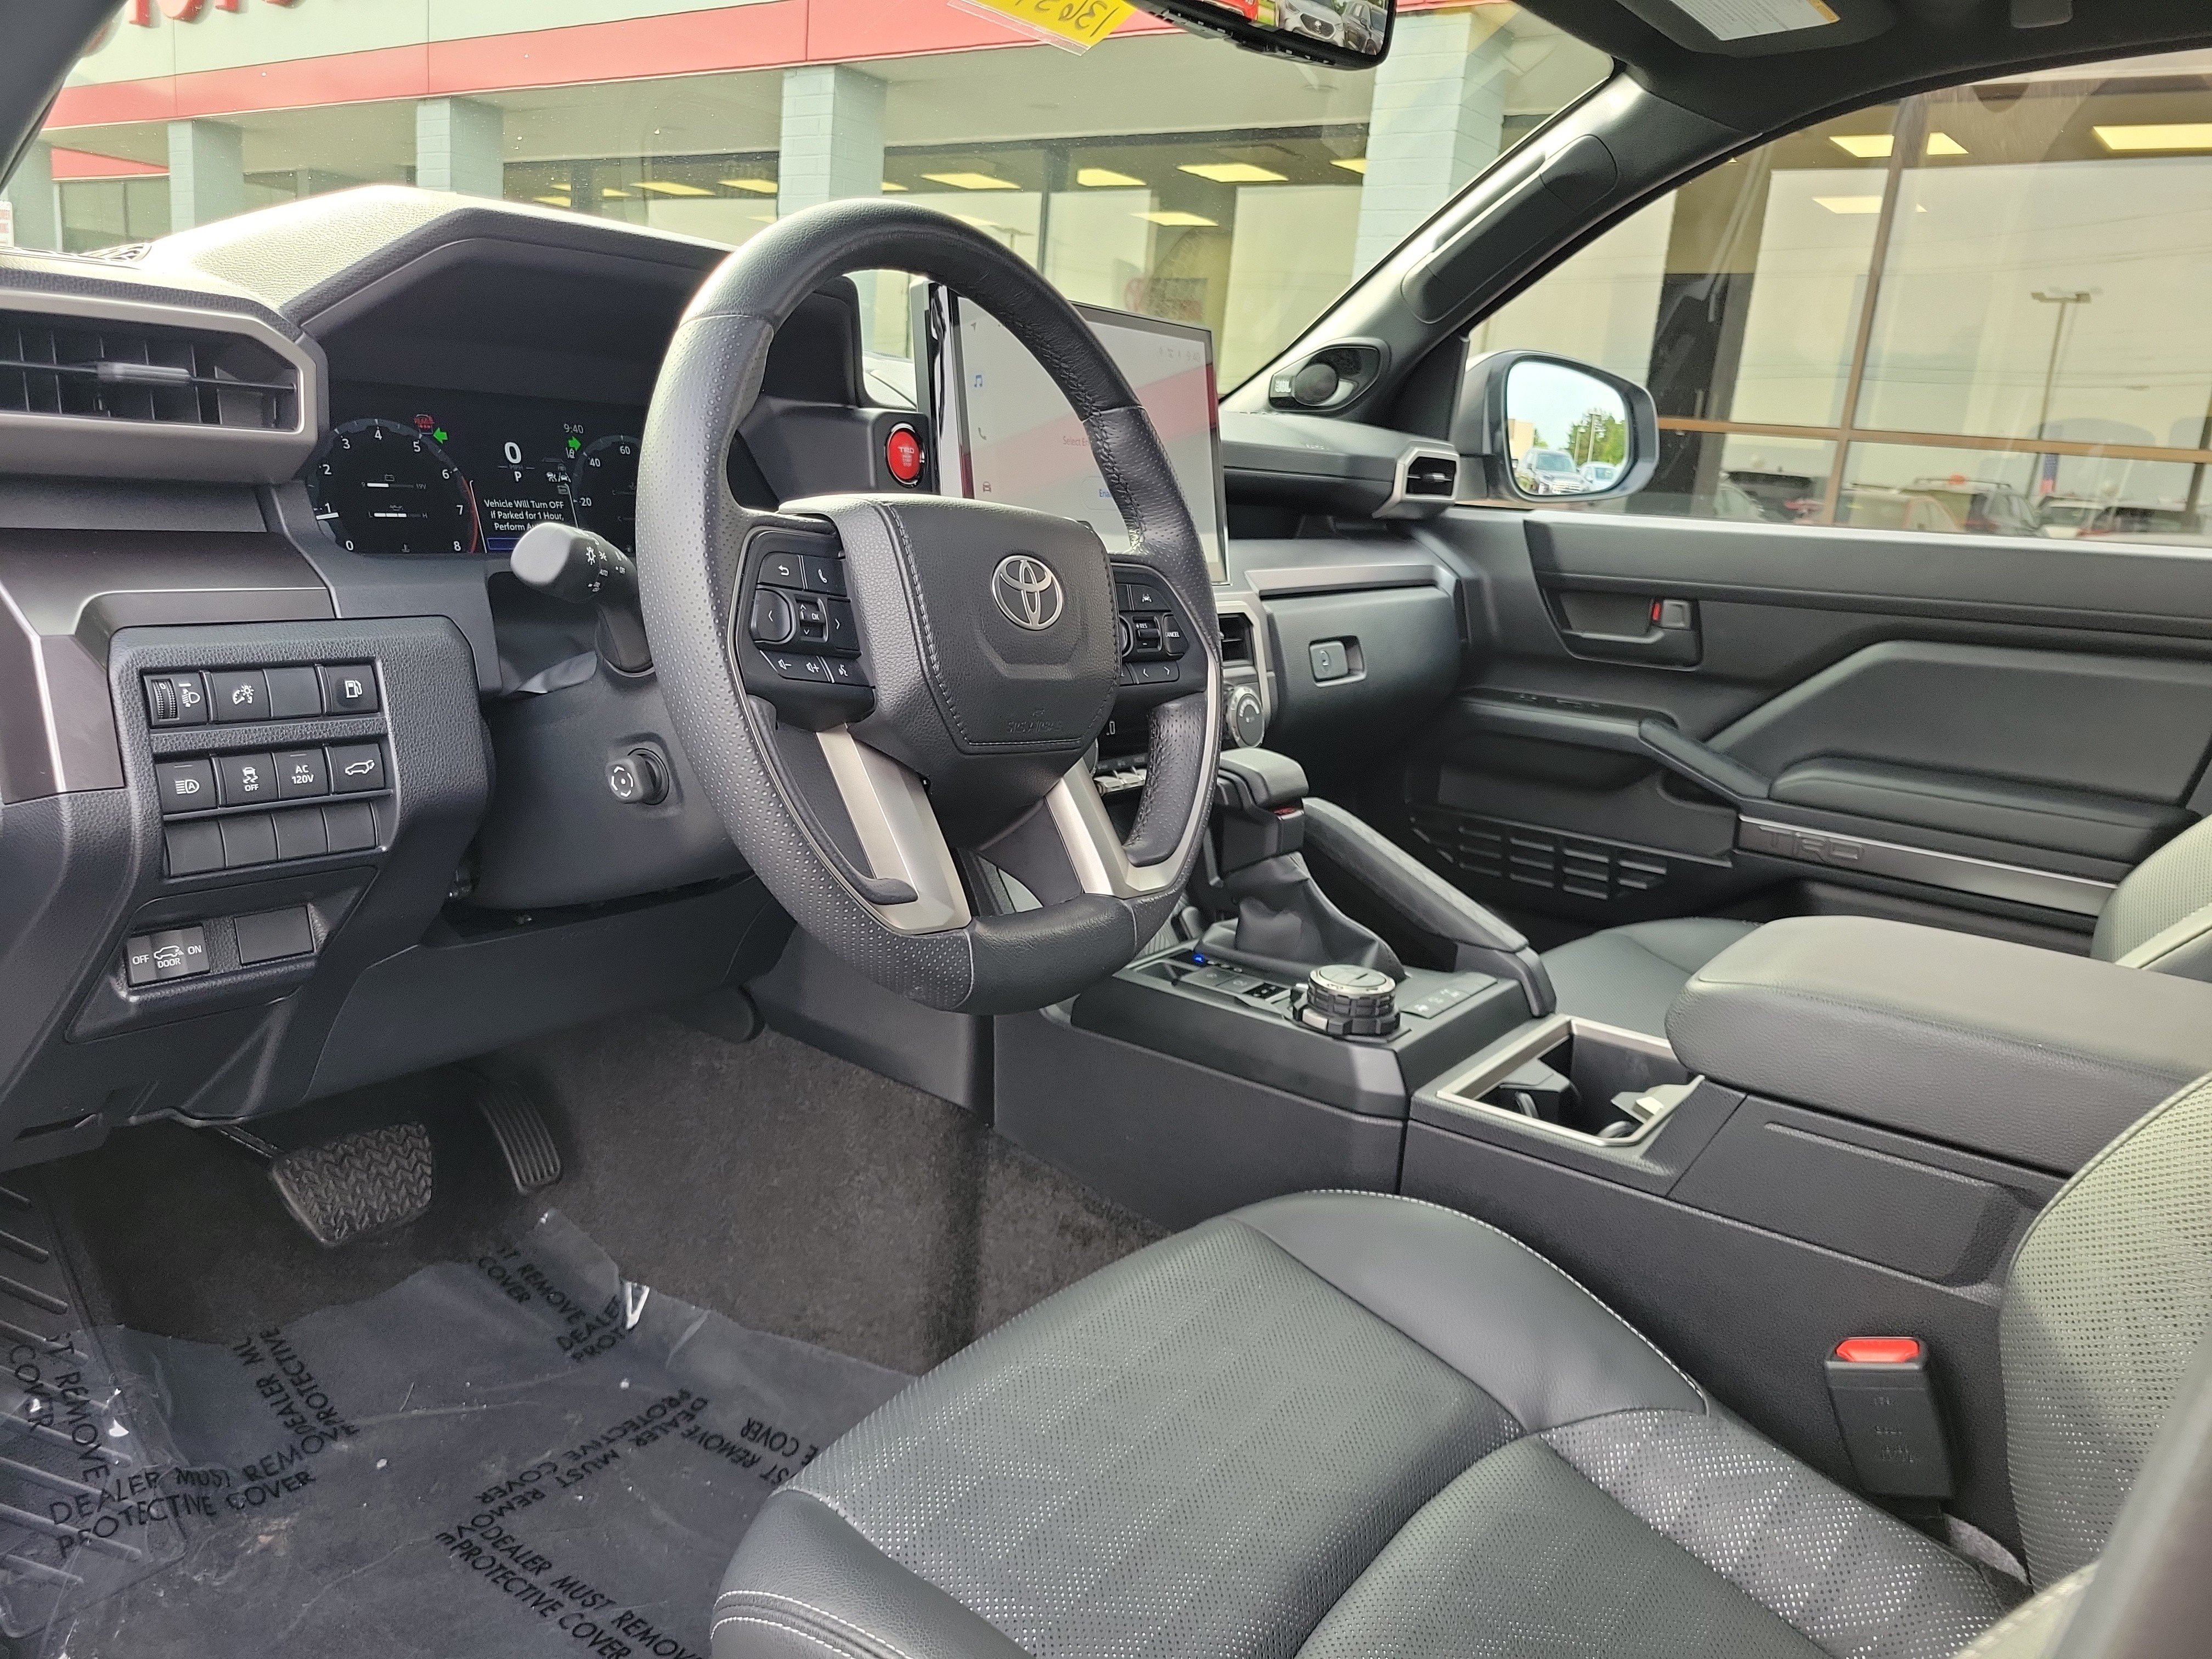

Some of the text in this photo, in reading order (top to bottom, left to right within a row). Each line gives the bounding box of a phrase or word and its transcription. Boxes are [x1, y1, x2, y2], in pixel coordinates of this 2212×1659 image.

[375, 430, 382, 439] 4
[563, 424, 584, 434] 9:40
[343, 439, 351, 449] 3
[413, 441, 421, 452] 5
[504, 442, 522, 464] 0
[620, 446, 631, 455] 60
[590, 458, 601, 467] 40
[323, 464, 332, 475] 2
[442, 469, 450, 479] 6
[514, 471, 522, 482] P
[325, 503, 331, 512] 1
[484, 499, 513, 509] Vehicle
[514, 500, 530, 509] Will
[531, 500, 549, 509] Turn
[580, 498, 592, 506] 20
[456, 505, 464, 515] 7
[490, 511, 496, 519] If
[497, 511, 524, 520] Parked
[526, 511, 537, 520] for
[544, 512, 564, 521] Hour,
[494, 522, 525, 531] Perform
[345, 540, 354, 550] 0
[453, 540, 461, 551] 8
[295, 765, 309, 774] AC
[291, 774, 314, 785] 120V
[244, 783, 259, 792] OFF
[187, 945, 202, 955] ON
[132, 953, 150, 965] OFF
[157, 957, 181, 969] DOOR
[477, 1256, 531, 1304] COVER
[55, 1371, 110, 1482] REMOVE
[741, 1417, 799, 1457] COVER
[680, 1424, 761, 1468] REMOVE
[176, 1467, 231, 1488] MUST
[246, 1424, 361, 1481] REMOVE
[555, 1448, 620, 1488] MUST
[475, 1461, 558, 1504] COVER
[225, 1471, 316, 1510] COVER
[436, 1488, 546, 1546] REMOVE
[480, 1525, 552, 1576] DEALER
[550, 1575, 617, 1609] MUST
[451, 1538, 631, 1659] PROTECTIVE COVER
